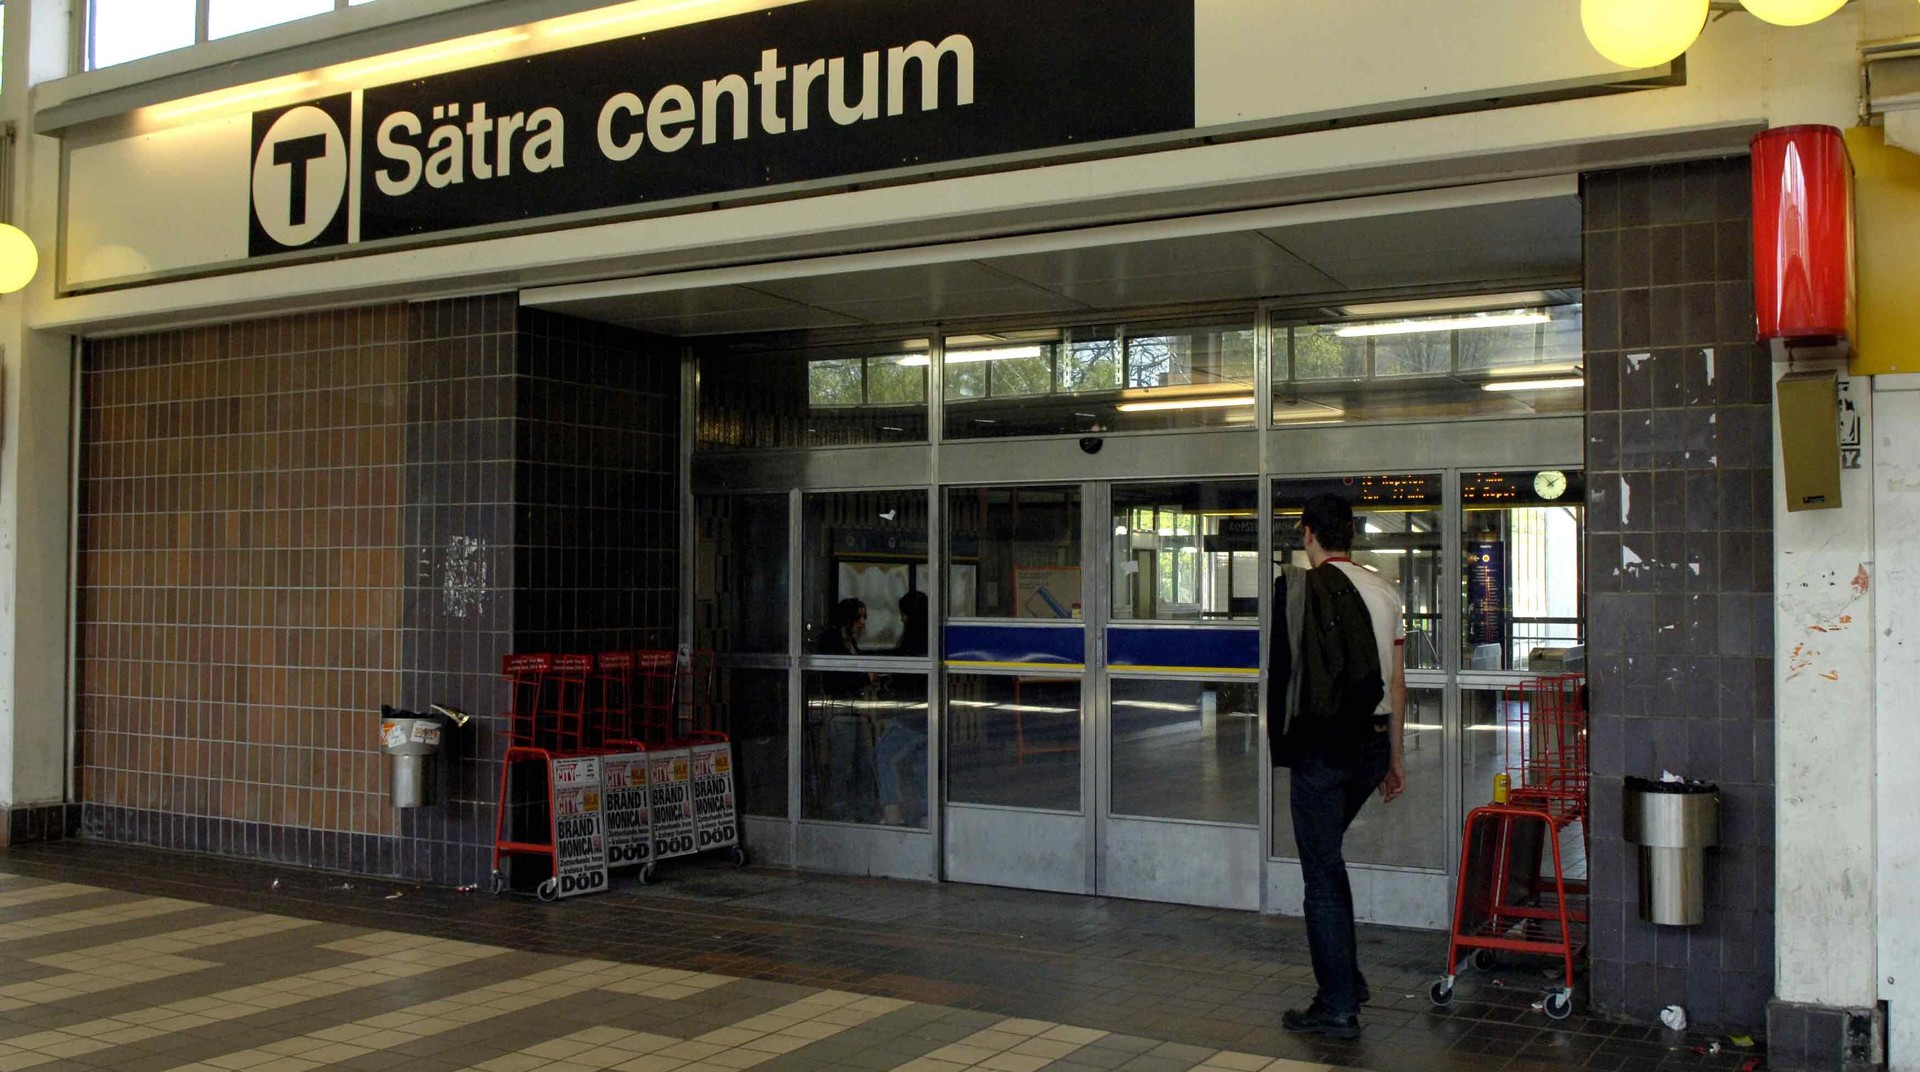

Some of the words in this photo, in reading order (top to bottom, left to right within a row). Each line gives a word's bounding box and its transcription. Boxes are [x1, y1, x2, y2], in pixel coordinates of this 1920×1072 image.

[272, 133, 327, 226] T
[375, 100, 564, 197] Sätra
[597, 33, 974, 162] centrum
[557, 768, 576, 784] CITY
[653, 786, 684, 806] BRAND
[695, 778, 726, 798] BRAND
[607, 792, 641, 811] BRAND
[695, 795, 725, 815] MONICA
[607, 810, 640, 829] MONICA
[654, 803, 684, 824] MONICA
[558, 818, 593, 839] BRAND
[699, 825, 735, 846] DÖD
[559, 837, 593, 858] MONICA
[608, 843, 650, 862] DÖD
[655, 835, 693, 855] DÖD
[561, 871, 604, 893] DÖD
